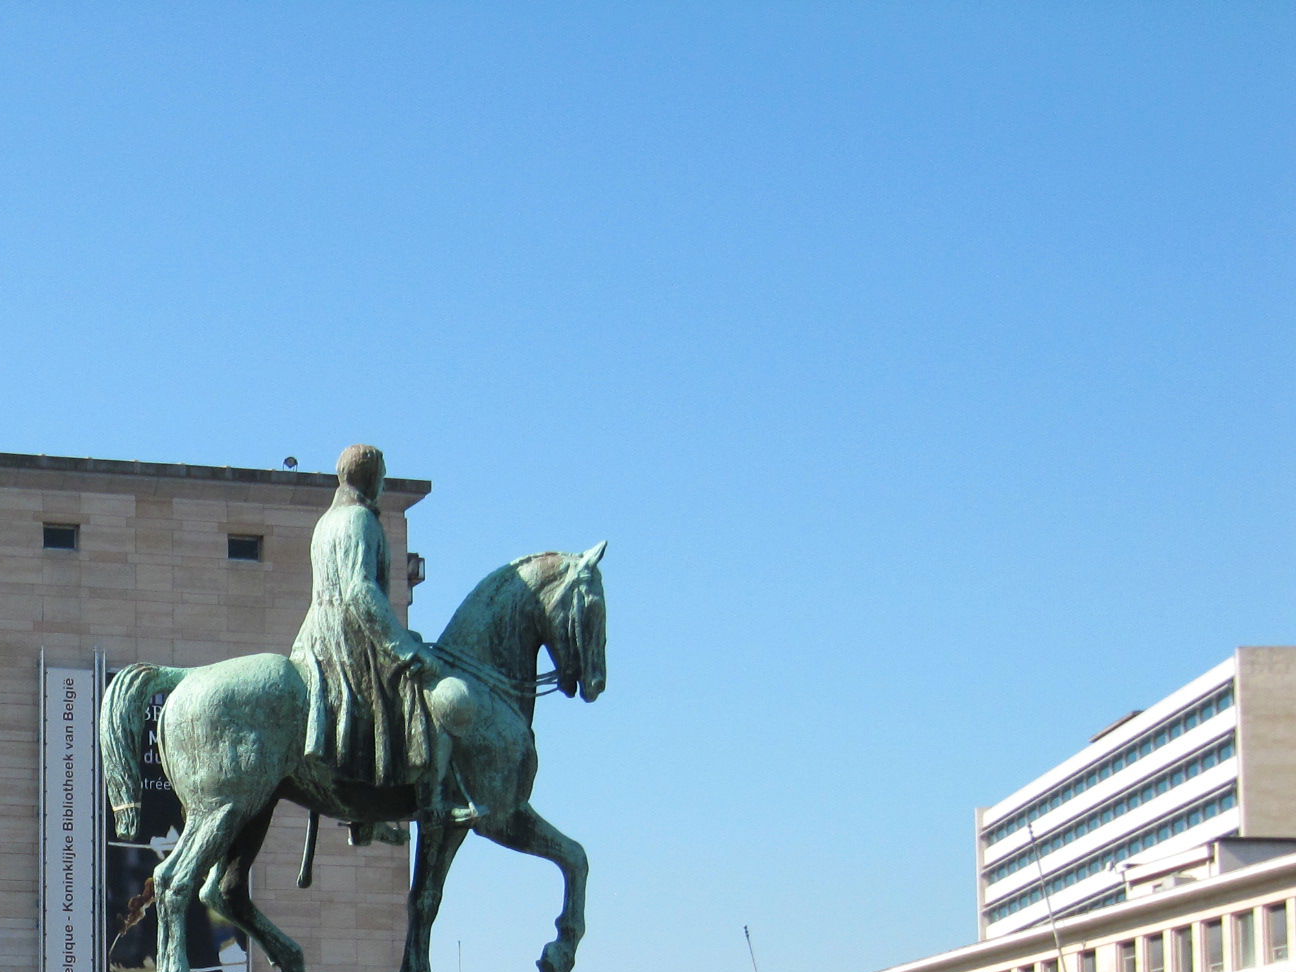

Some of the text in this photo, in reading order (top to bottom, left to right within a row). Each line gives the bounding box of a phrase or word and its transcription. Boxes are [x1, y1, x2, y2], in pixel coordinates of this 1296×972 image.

[62, 677, 76, 721] België
[64, 726, 74, 750] van
[62, 753, 74, 831] Bibliotheek
[141, 777, 172, 790] trée
[62, 835, 76, 912] Koninklijke
